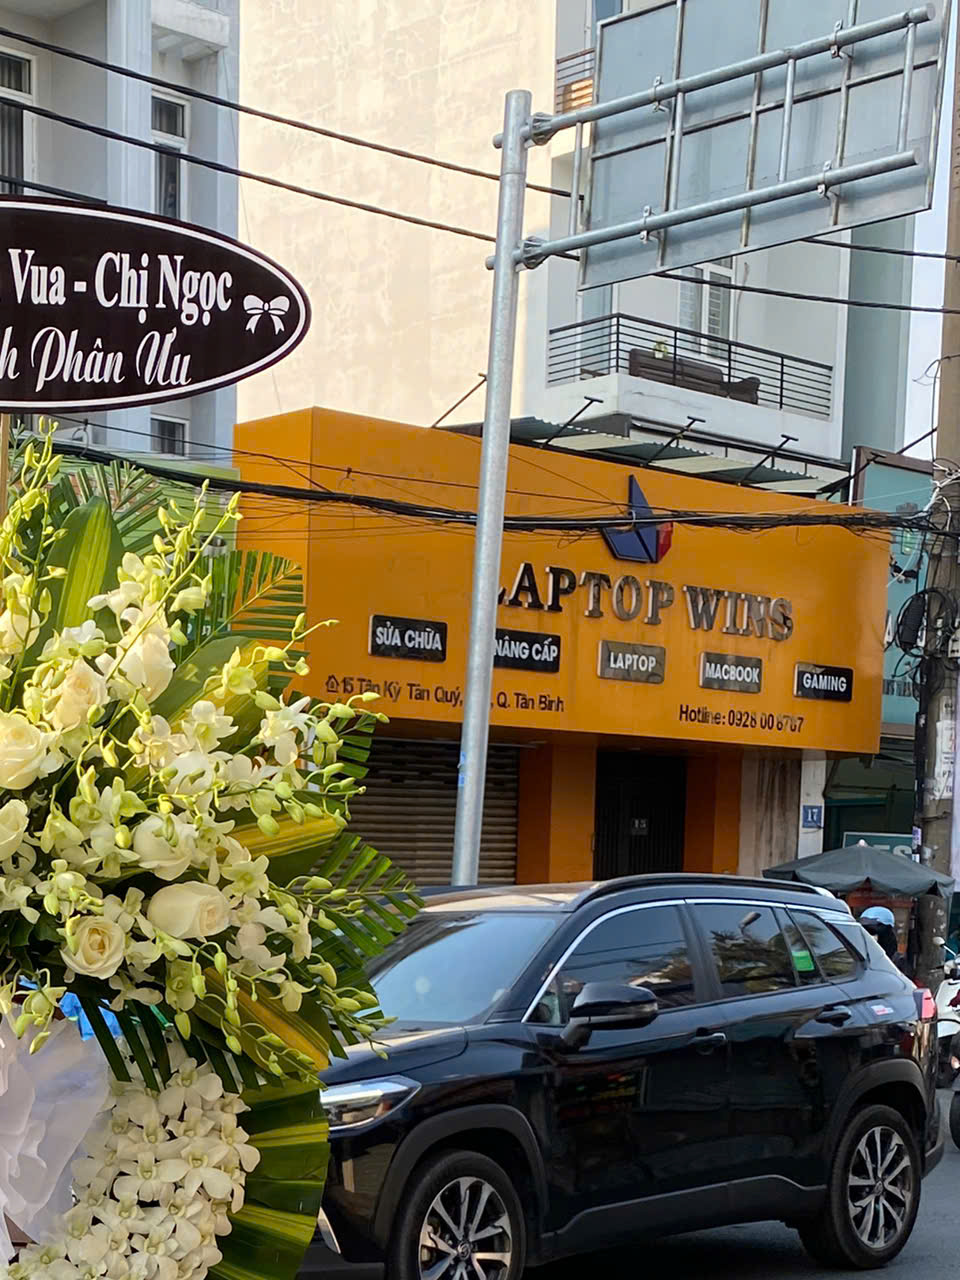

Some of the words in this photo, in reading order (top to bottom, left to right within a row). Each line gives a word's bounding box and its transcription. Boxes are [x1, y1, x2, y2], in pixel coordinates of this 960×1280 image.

[8, 248, 66, 306] Vua
[74, 280, 87, 292] -
[95, 252, 149, 324] Chị
[156, 254, 233, 327] Ngọc
[31, 326, 127, 392] Phân
[135, 327, 193, 388] Ưu
[683, 585, 794, 641] WINS
[375, 621, 402, 648] SỬA
[405, 628, 442, 651] CHỮA
[495, 635, 530, 660] NÂNG
[532, 637, 559, 662] CẤP
[610, 651, 656, 672] LAPTOP
[705, 662, 760, 684] MACBOOK
[357, 678, 381, 695] Tân
[407, 683, 431, 701] Tân
[497, 691, 511, 709] Q.
[514, 692, 535, 710] Tân
[539, 694, 565, 713] Bình
[803, 672, 847, 693] GAMING
[679, 703, 726, 725] Hotline:
[760, 711, 775, 731] 00
[807, 808, 818, 822] 17
